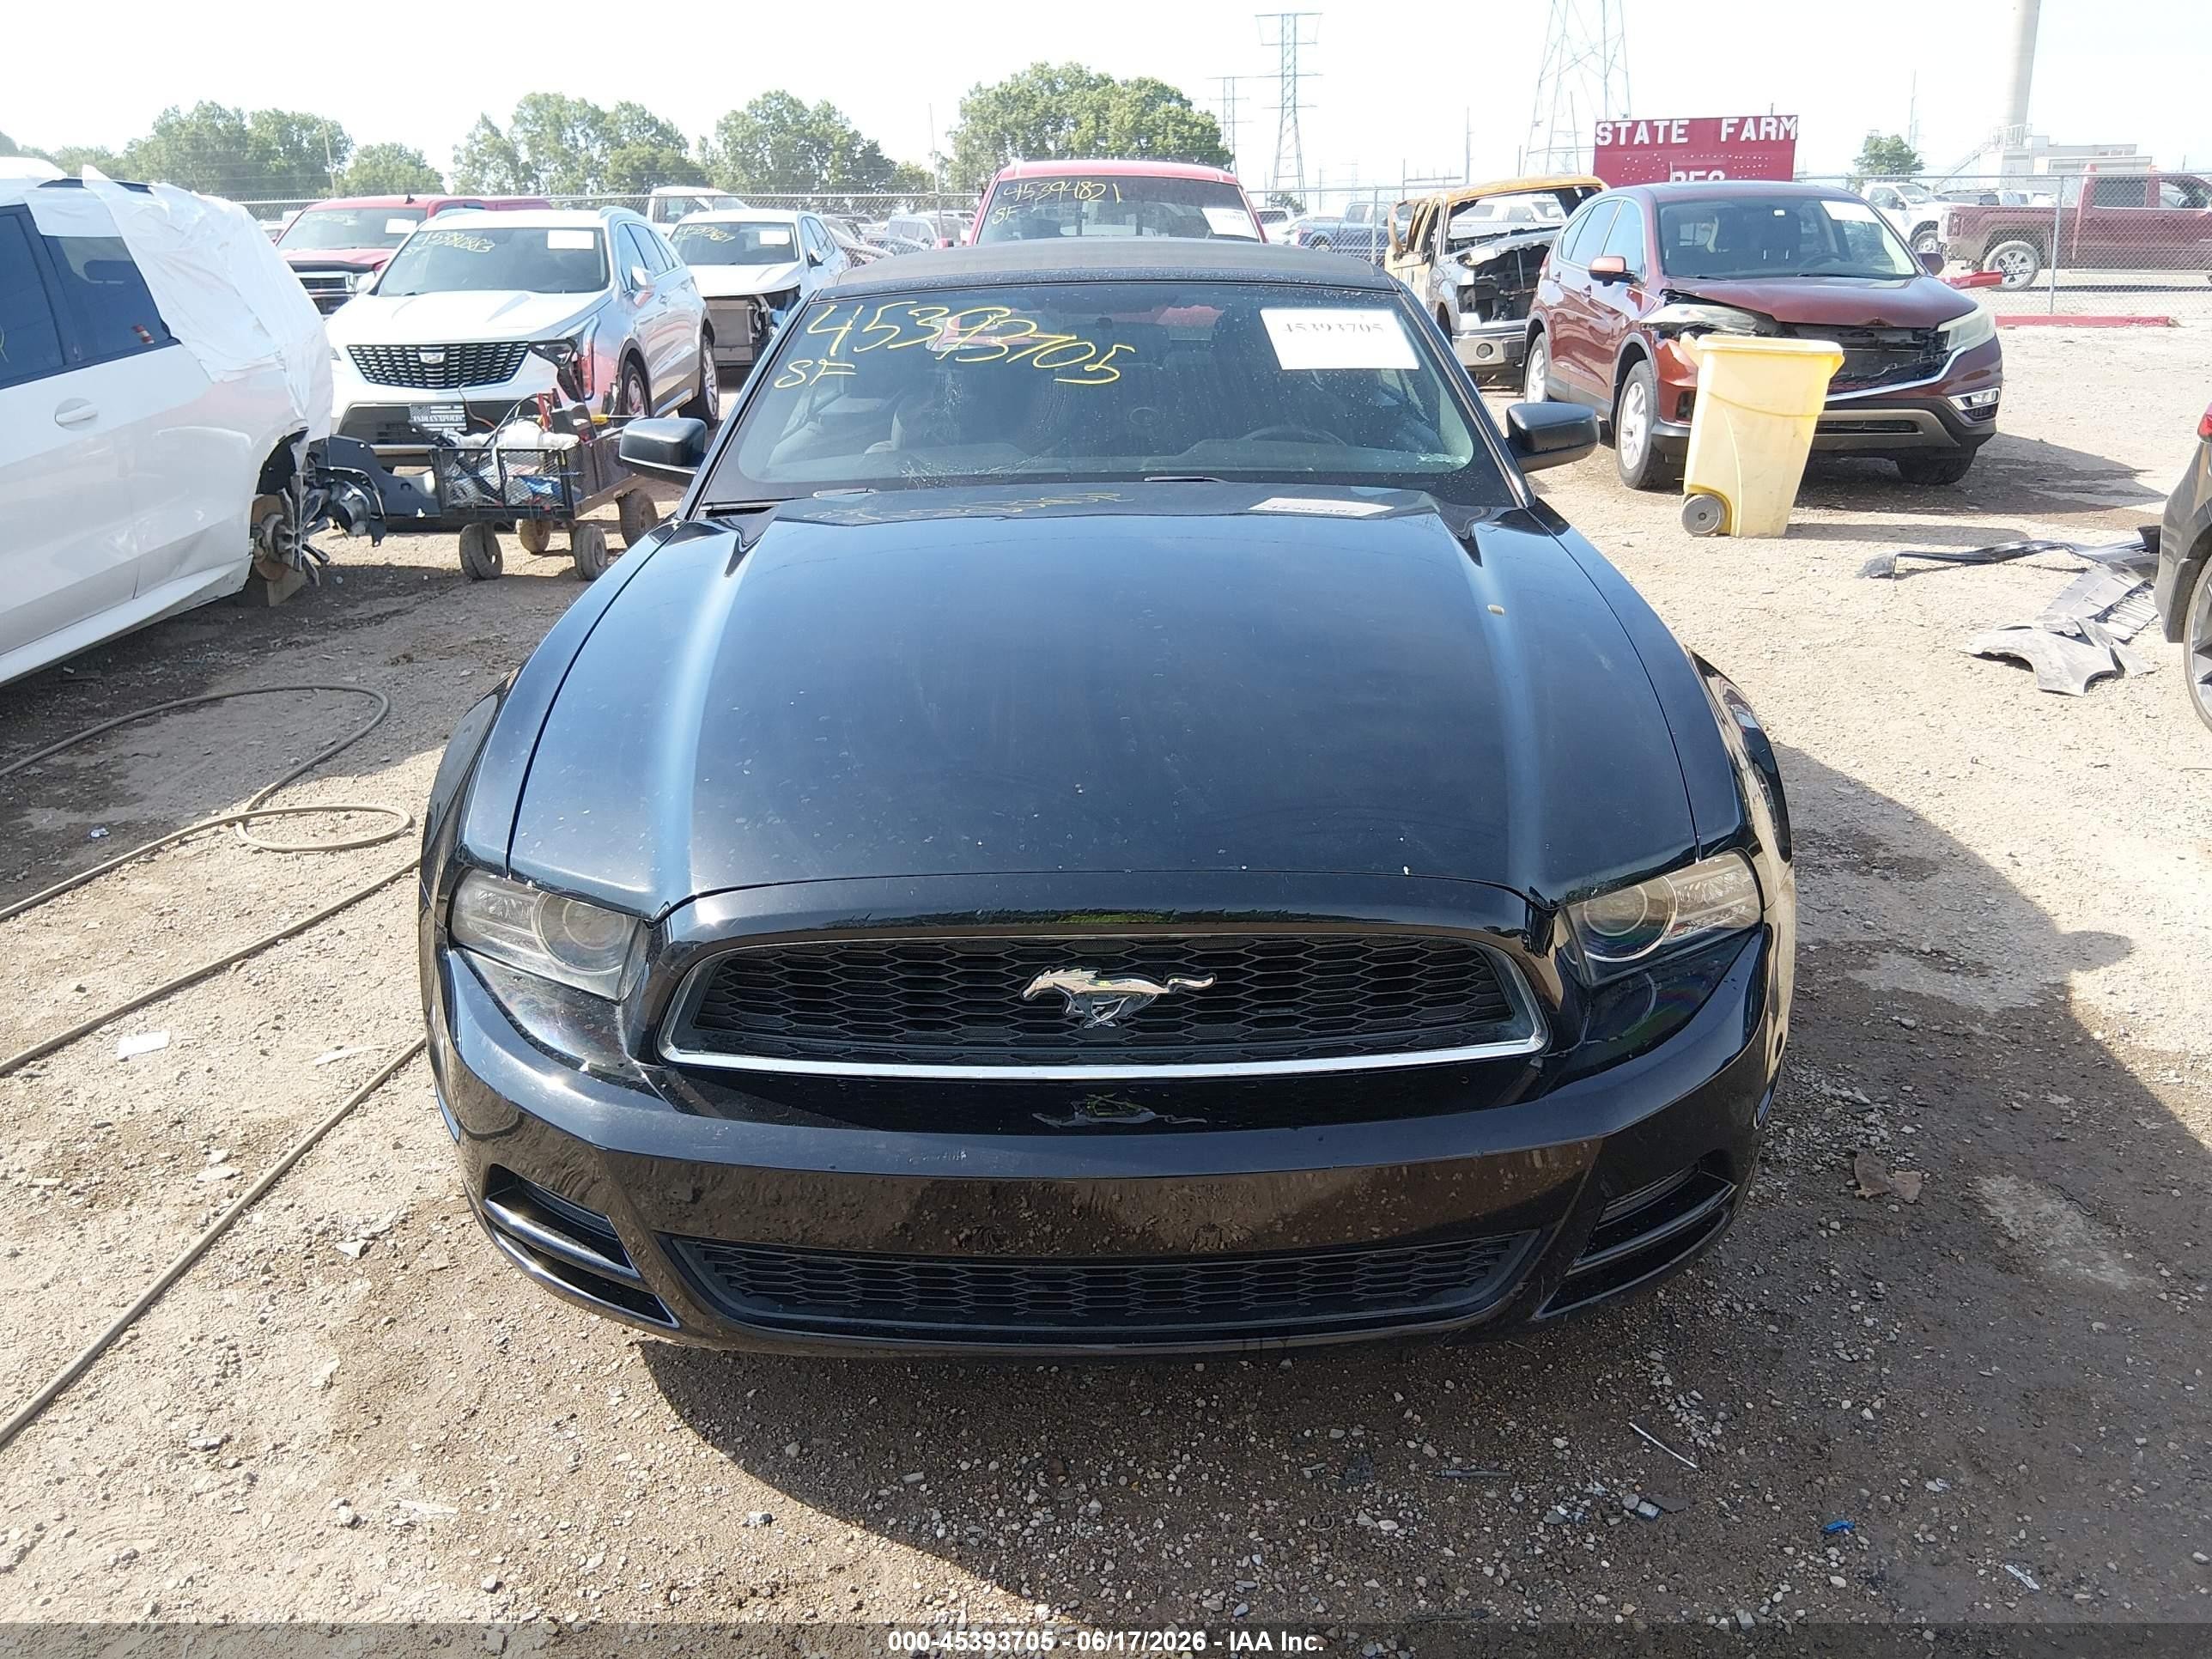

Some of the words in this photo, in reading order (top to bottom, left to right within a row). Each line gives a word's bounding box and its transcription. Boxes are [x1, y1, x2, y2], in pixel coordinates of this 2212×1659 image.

[1595, 119, 1690, 146] STATE
[1720, 116, 1798, 142] FARM
[1003, 180, 1122, 204] 45394821
[991, 204, 1022, 225] SF
[807, 301, 1136, 384] 45393705
[774, 359, 857, 388] SF
